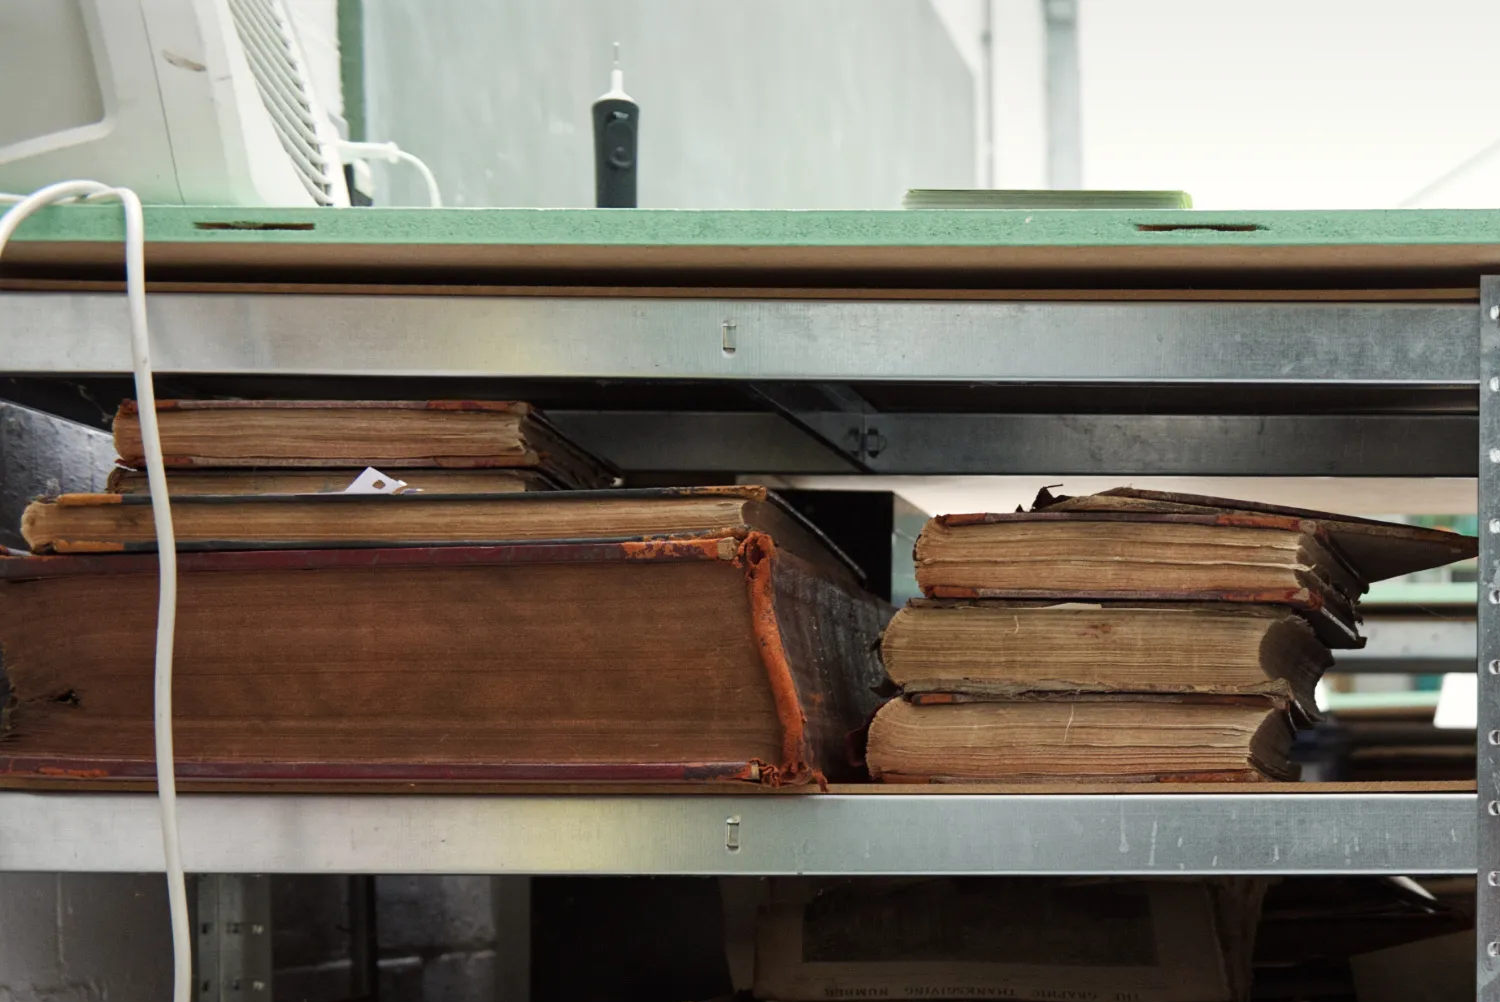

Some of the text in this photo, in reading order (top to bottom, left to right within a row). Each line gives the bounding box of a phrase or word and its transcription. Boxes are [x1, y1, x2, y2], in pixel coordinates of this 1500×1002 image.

[824, 987, 889, 998] NUMBER
[904, 986, 1018, 997] THANKSGIVING
[1031, 989, 1098, 1000] GRAPHIC
